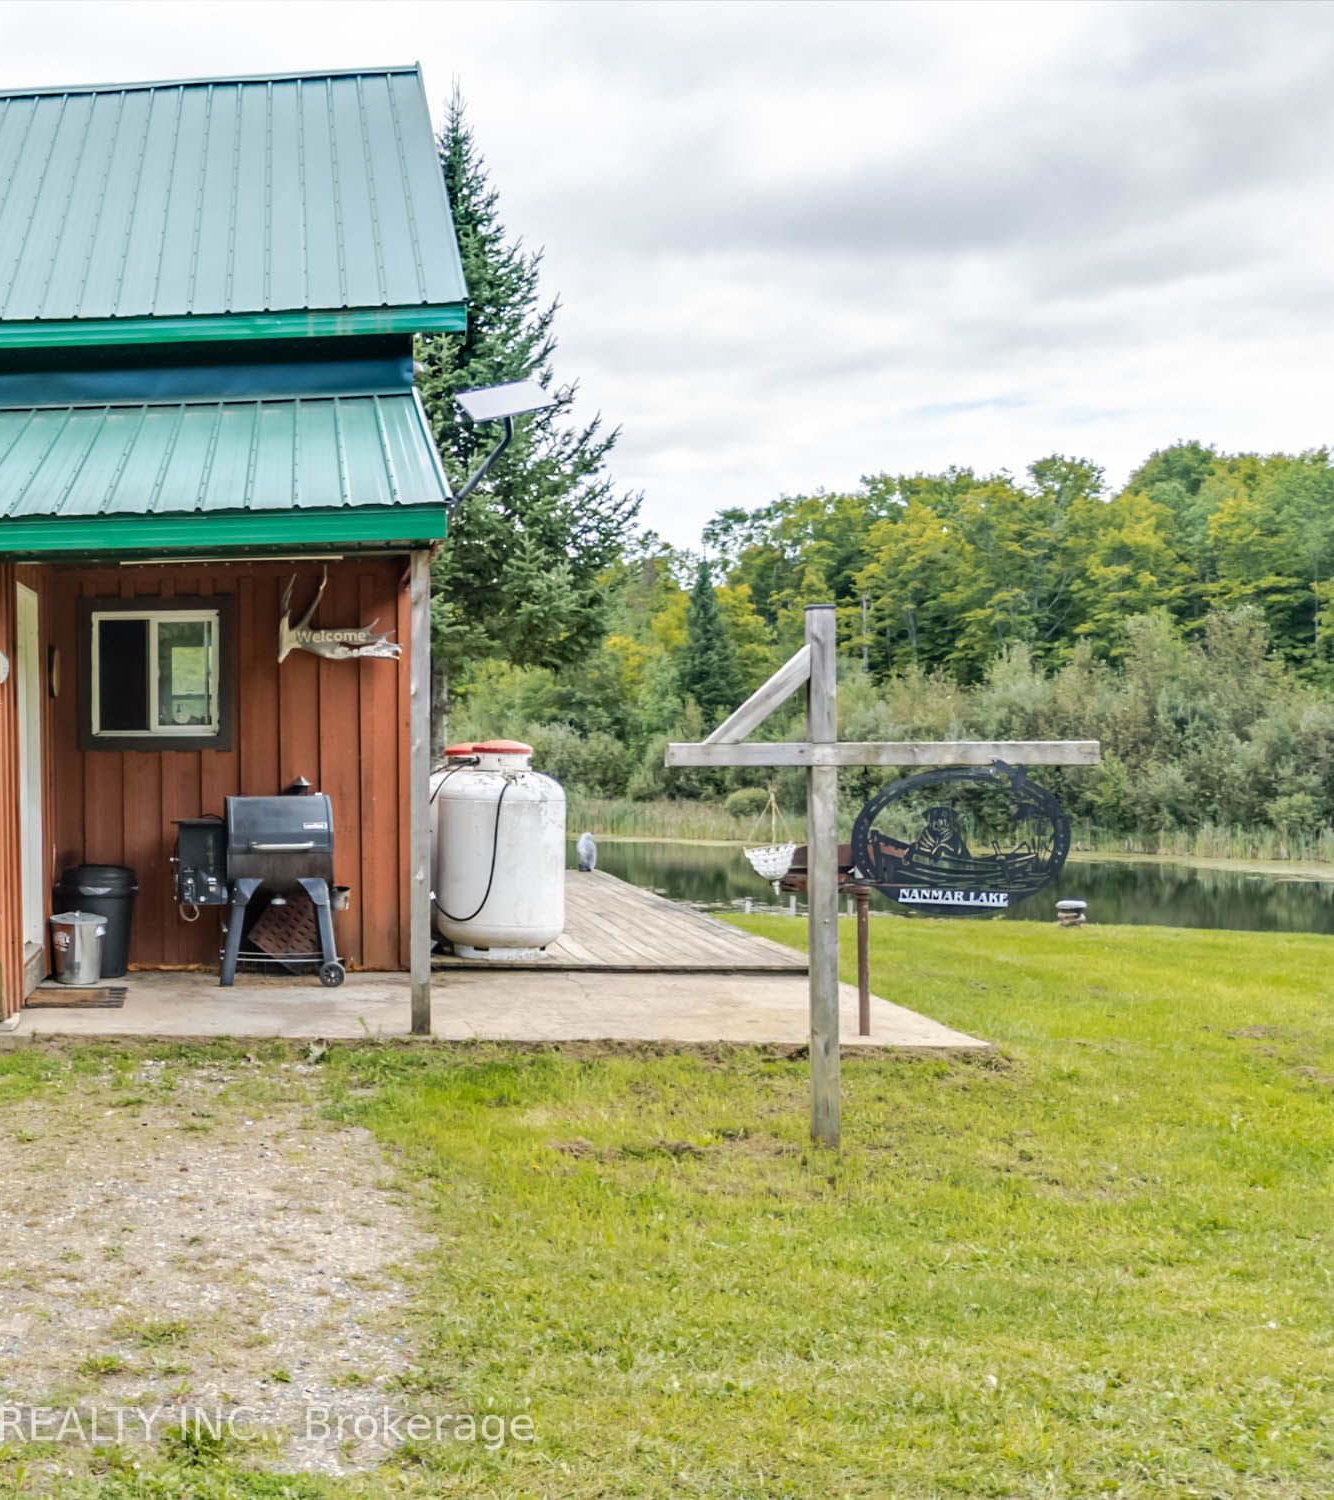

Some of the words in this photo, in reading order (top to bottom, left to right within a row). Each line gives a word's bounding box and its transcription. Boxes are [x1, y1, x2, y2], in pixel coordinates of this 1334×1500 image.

[297, 629, 367, 643] Welcome
[899, 888, 964, 902] NANMAR
[969, 891, 1009, 904] LAKE
